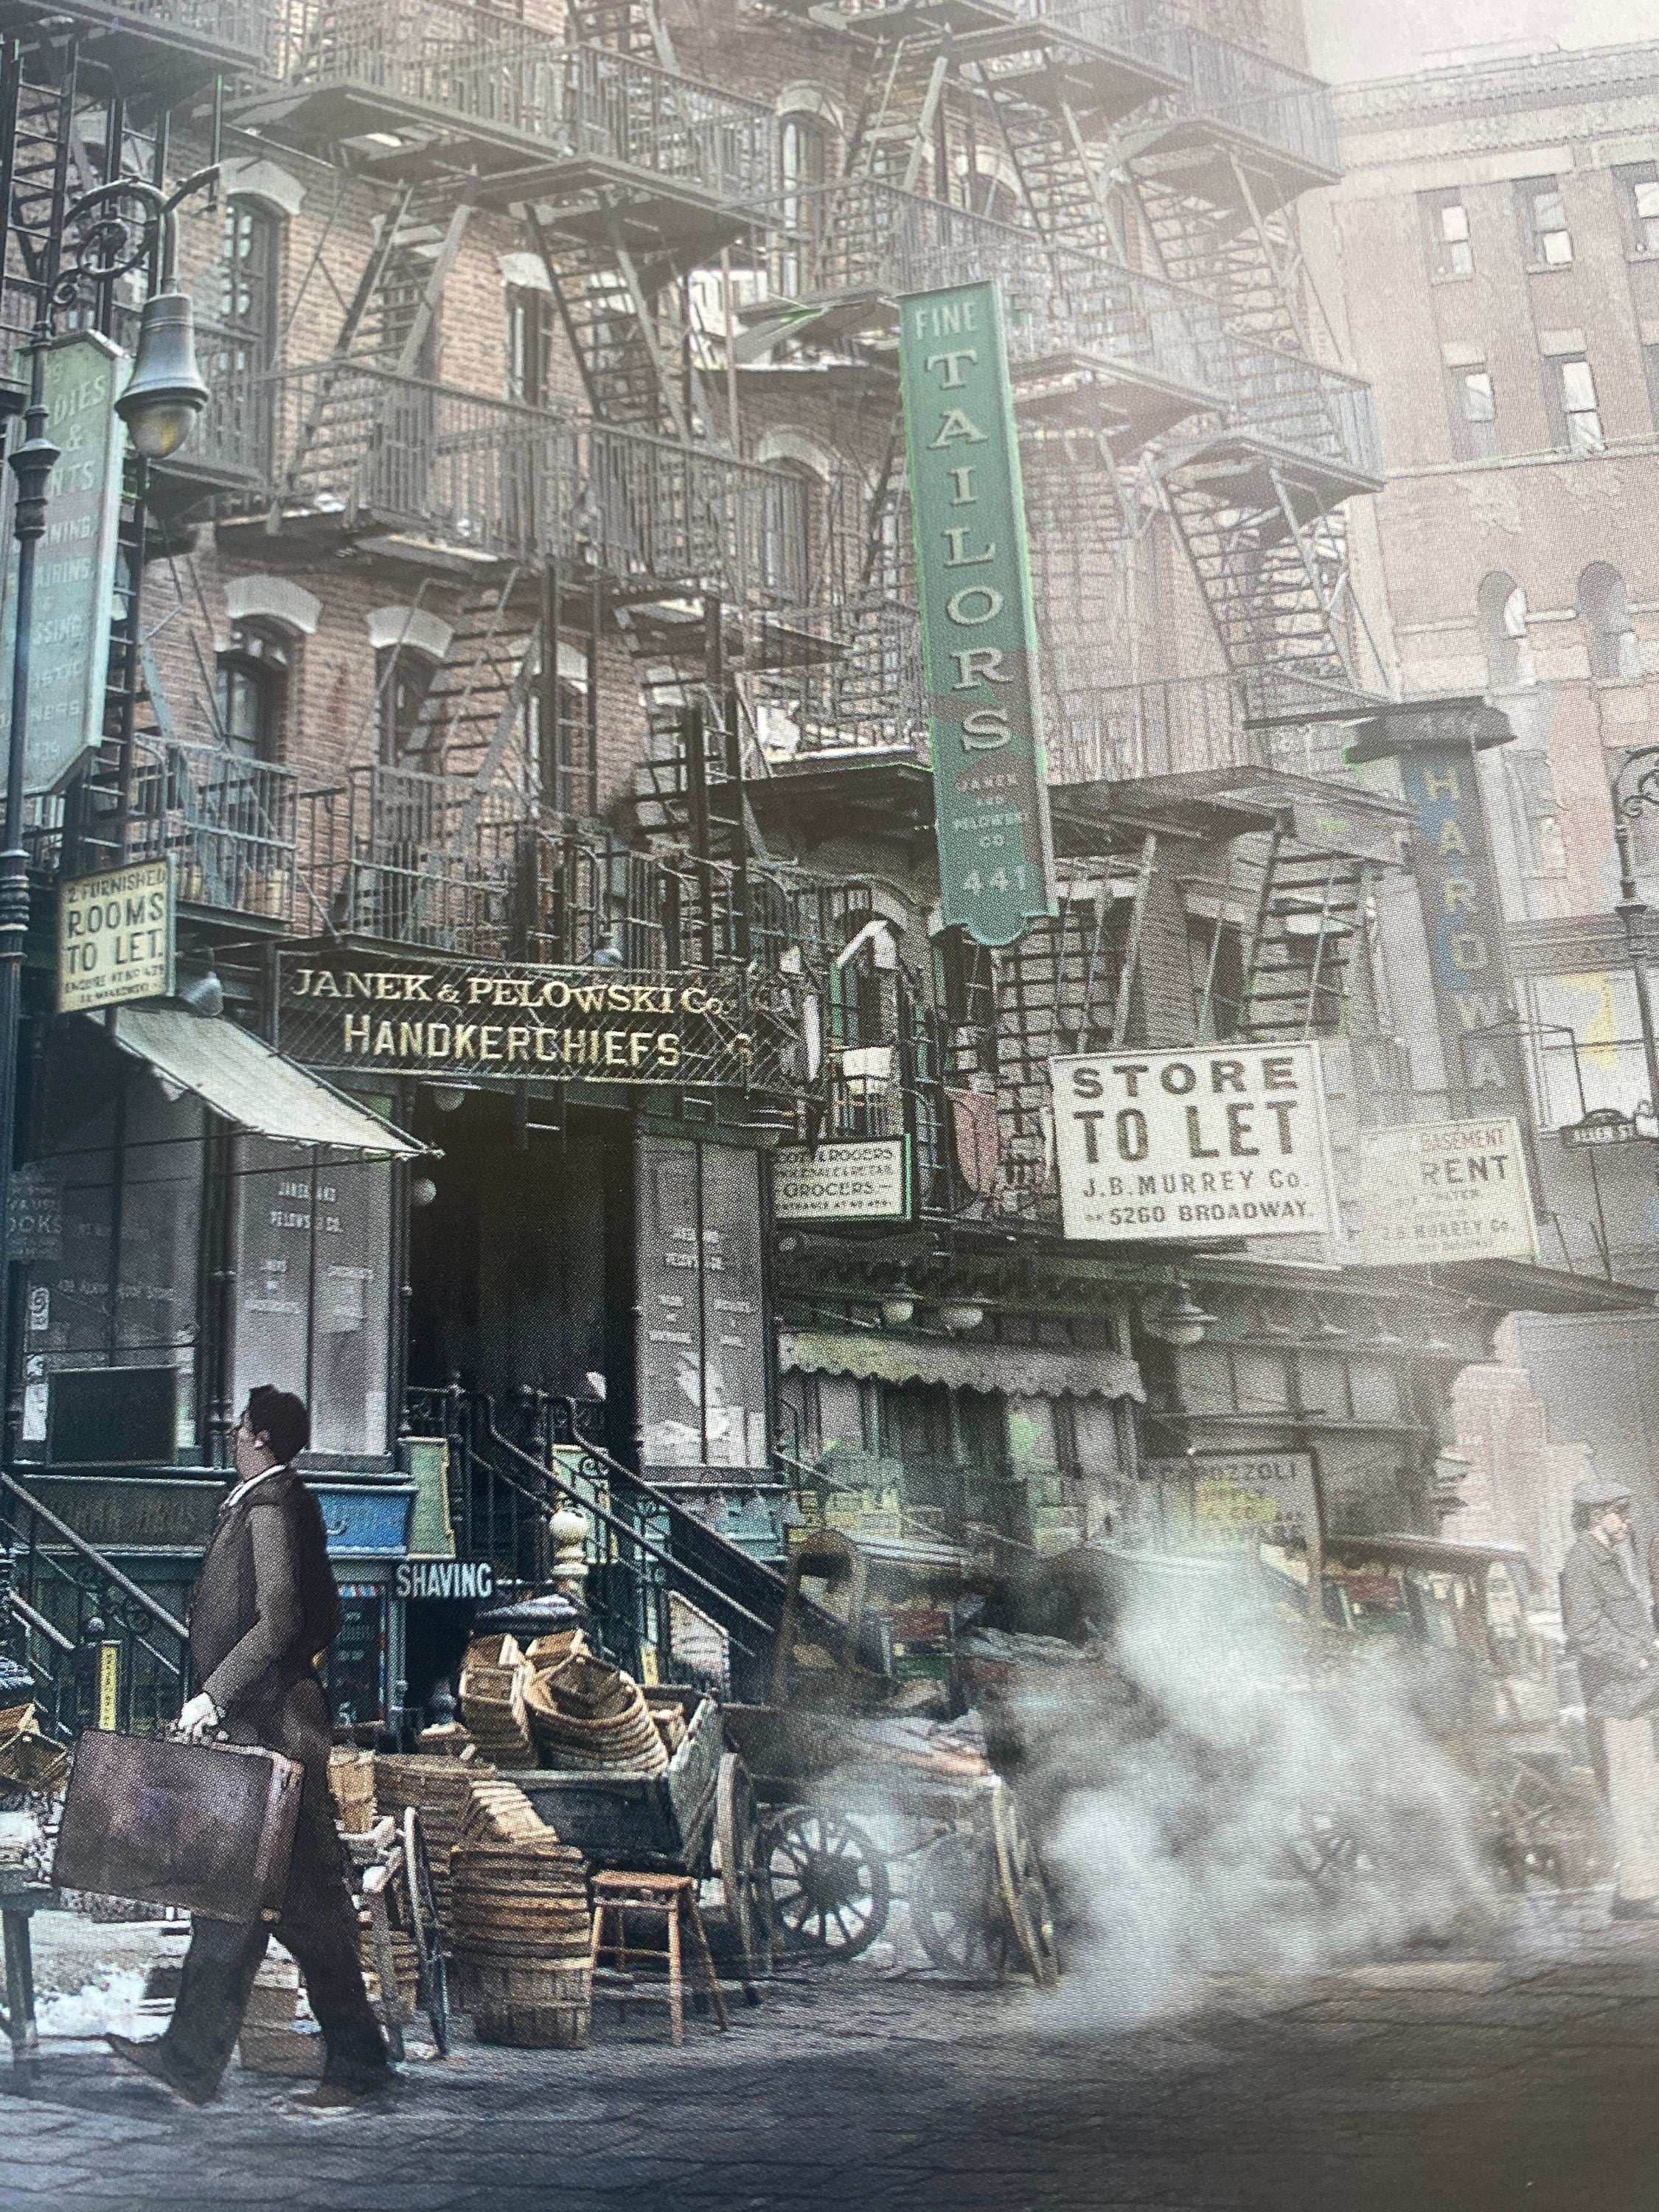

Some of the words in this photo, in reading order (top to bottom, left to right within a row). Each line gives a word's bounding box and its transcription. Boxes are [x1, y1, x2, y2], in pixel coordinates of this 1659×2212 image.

[914, 301, 979, 341] FINE
[46, 375, 105, 429] DIES
[925, 349, 1014, 753] TAILORS
[82, 867, 167, 900] FURNISHED
[961, 865, 1026, 897] 441
[67, 891, 164, 939] ROOMS
[66, 941, 97, 975] TO
[291, 969, 433, 1001] JANEK
[437, 984, 460, 1005] &
[468, 976, 675, 1015] PELOWSKI
[344, 1014, 681, 1067] HANDKERCHIEFS
[1071, 1056, 1300, 1099] STORE
[1073, 1108, 1150, 1164] TO
[1185, 1100, 1298, 1158] LET
[1419, 1155, 1509, 1185] RENT
[397, 1562, 493, 1598] SHAVING
